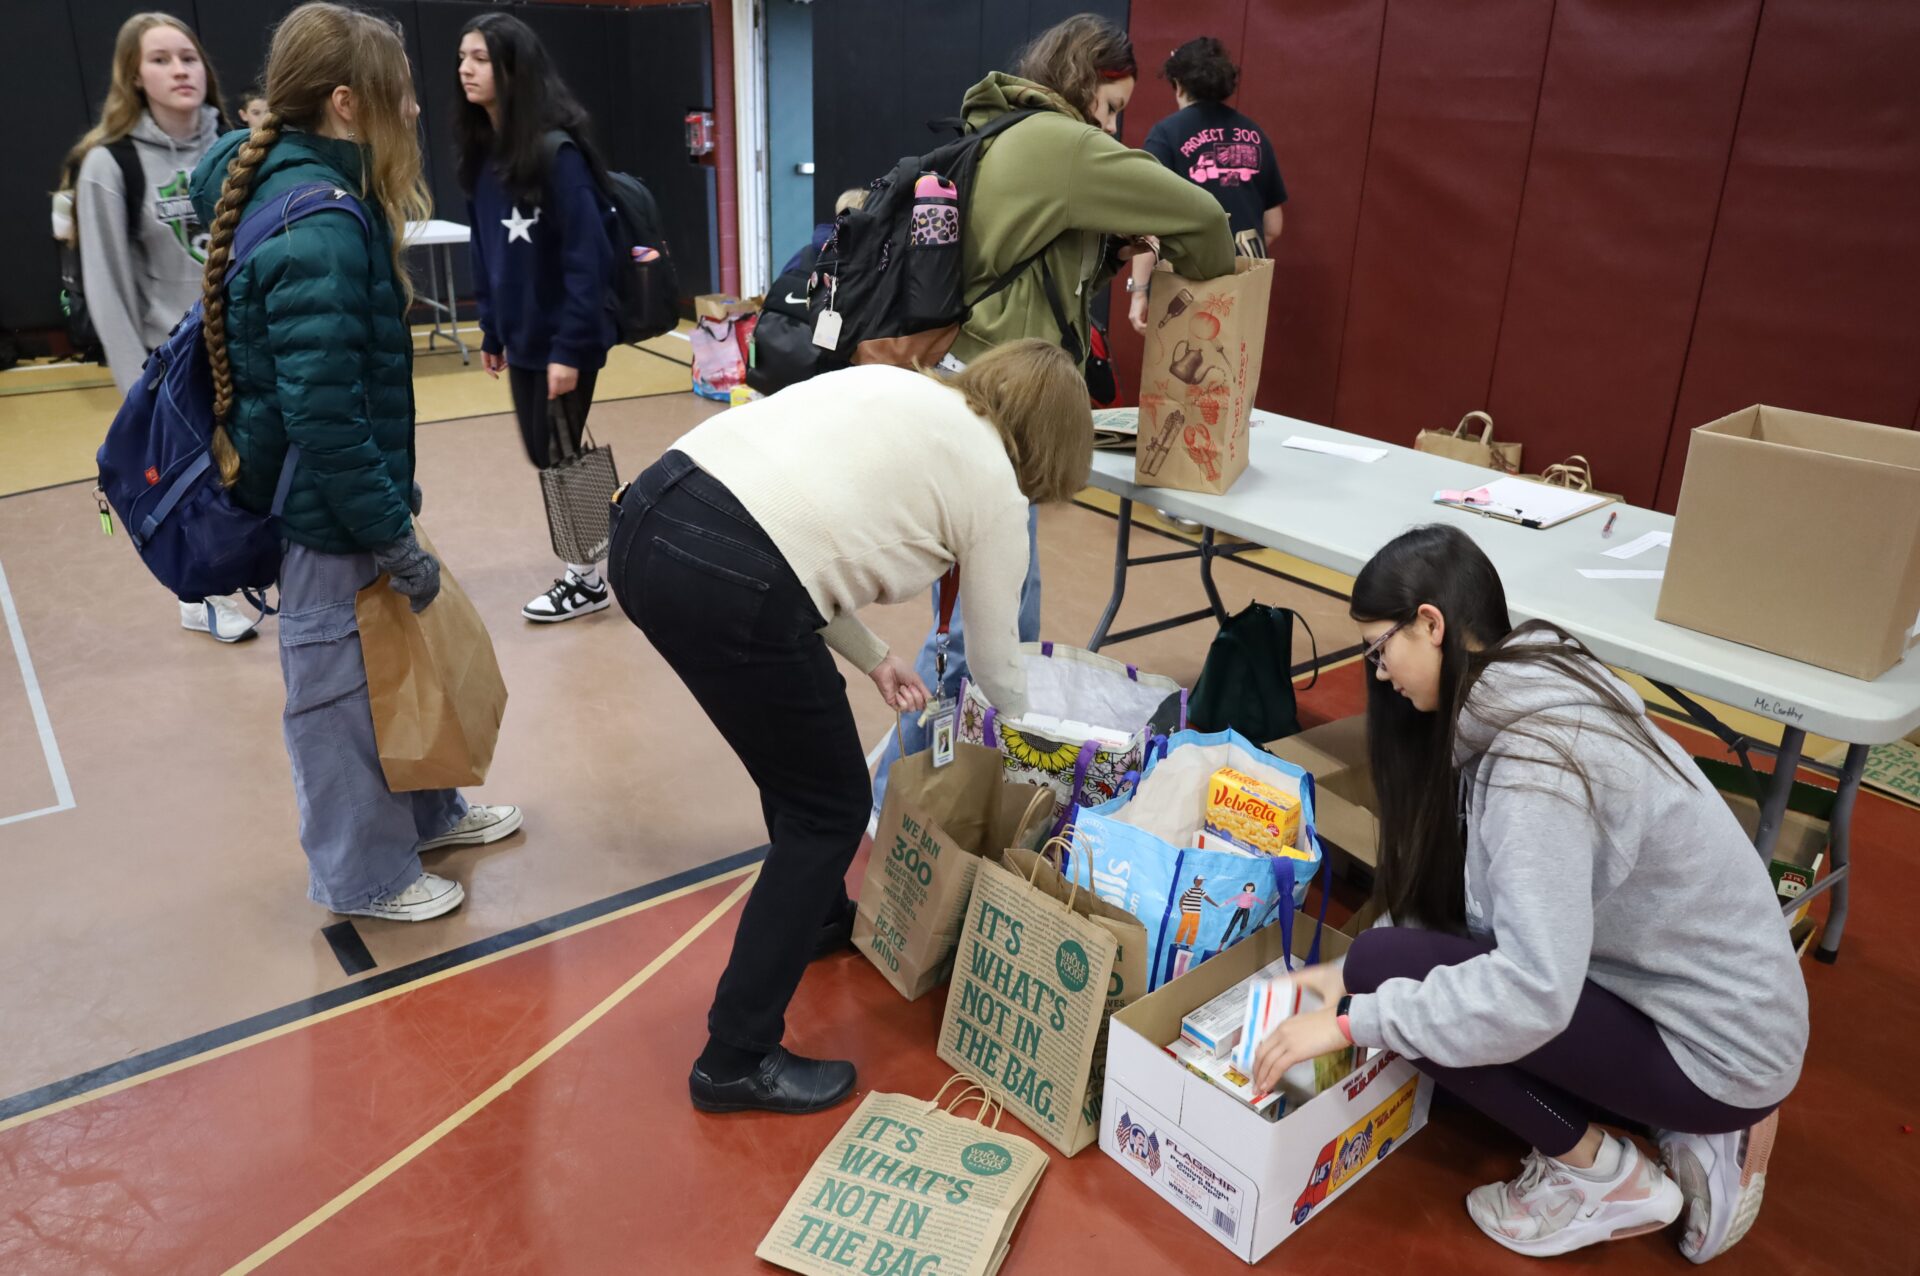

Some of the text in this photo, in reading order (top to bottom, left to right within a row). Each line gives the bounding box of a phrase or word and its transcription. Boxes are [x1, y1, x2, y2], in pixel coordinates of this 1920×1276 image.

[1180, 128, 1261, 158] PROJECT 300
[1214, 784, 1277, 823] Velveeta
[902, 812, 942, 860] WE BAN
[891, 834, 932, 887] 300
[874, 914, 908, 953] PEACE
[976, 901, 1024, 956] IT'S
[871, 933, 900, 973] MIND
[1060, 949, 1087, 974] WHOLE
[1060, 962, 1084, 984] FOODS
[970, 940, 1068, 1031] WHAT'S
[960, 979, 1011, 1035] NOT
[1011, 1013, 1044, 1061] IN
[955, 1017, 998, 1079] THE
[1001, 1052, 1055, 1123] BAG.
[856, 1116, 924, 1153] IT'S
[970, 1147, 1008, 1166] WHOLE
[836, 1144, 976, 1205] WHAT'S
[966, 1155, 1004, 1170] FOODS
[1165, 1138, 1237, 1194] FLAGSHIP
[1176, 1164, 1196, 1182] Copy
[1197, 1180, 1222, 1200] Paper
[810, 1178, 890, 1226] NOT
[884, 1198, 932, 1240] IN
[791, 1214, 866, 1267] THE
